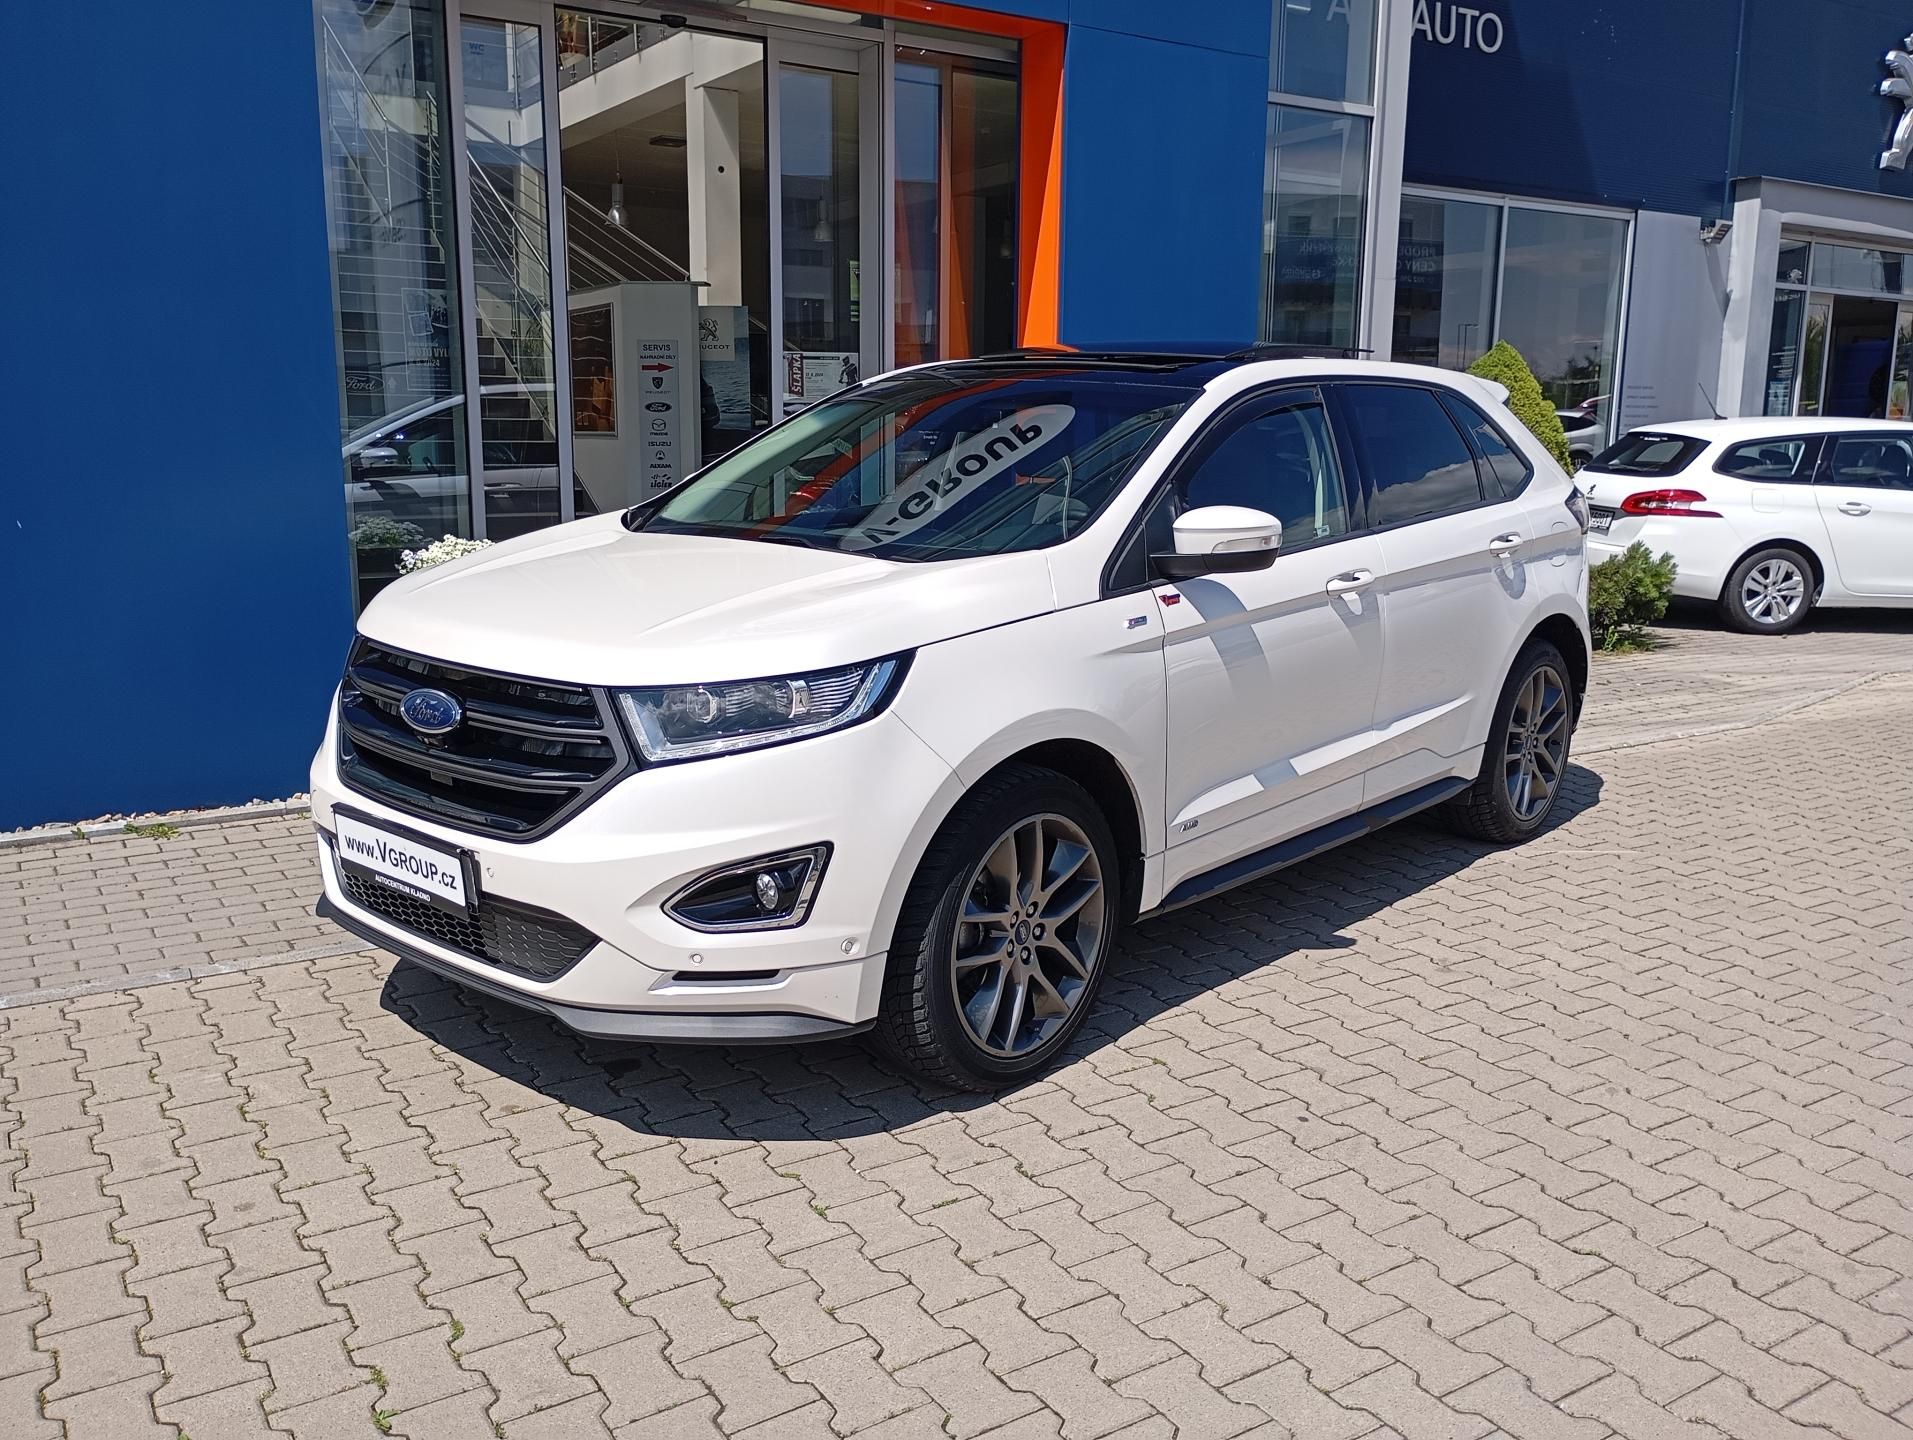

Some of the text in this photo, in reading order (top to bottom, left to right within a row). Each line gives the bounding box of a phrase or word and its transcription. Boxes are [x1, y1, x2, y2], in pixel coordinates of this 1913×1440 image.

[1411, 0, 1504, 54] AUTO
[642, 344, 671, 352] SERVIS
[792, 354, 802, 392] ŠLAPKA
[410, 695, 444, 724] Ford
[375, 873, 431, 902] AUTOCENTRUM KLADNO
